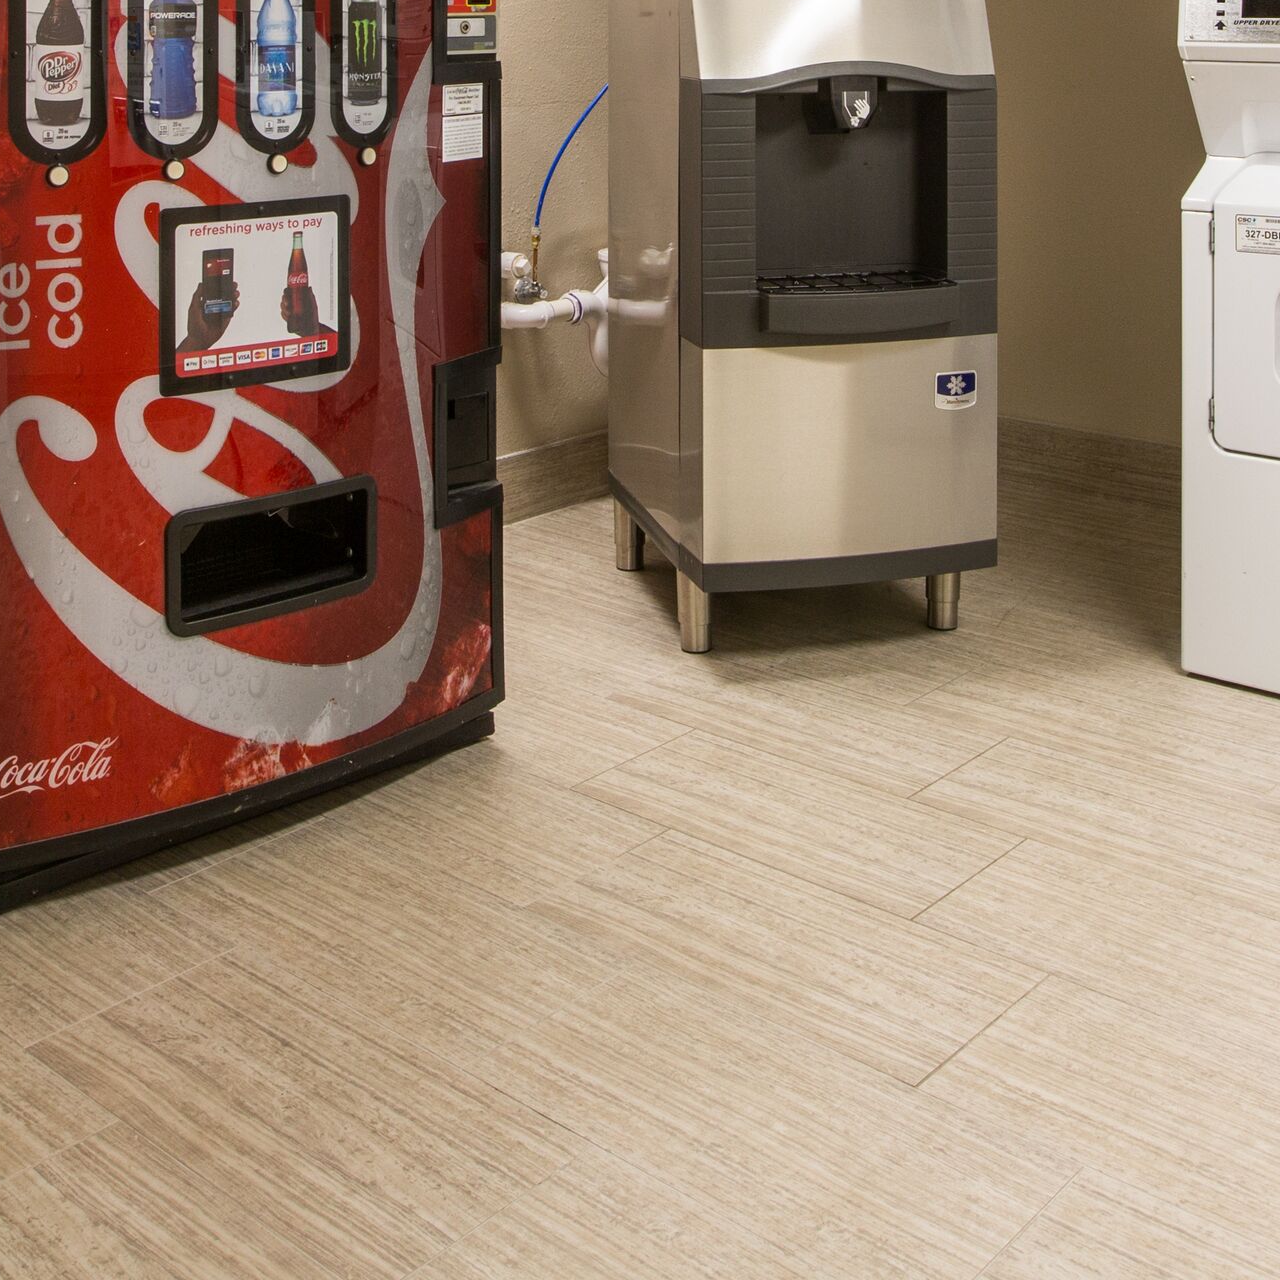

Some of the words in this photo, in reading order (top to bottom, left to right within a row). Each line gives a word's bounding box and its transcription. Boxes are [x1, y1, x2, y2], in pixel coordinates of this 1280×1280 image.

[149, 11, 197, 20] POWERADE
[42, 58, 77, 78] Pepper
[54, 55, 69, 68] Dr
[47, 81, 61, 91] Diet
[189, 221, 252, 238] refreshing
[255, 220, 285, 234] ways
[287, 218, 300, 230] to
[302, 216, 323, 232] pay
[35, 213, 84, 349] cold
